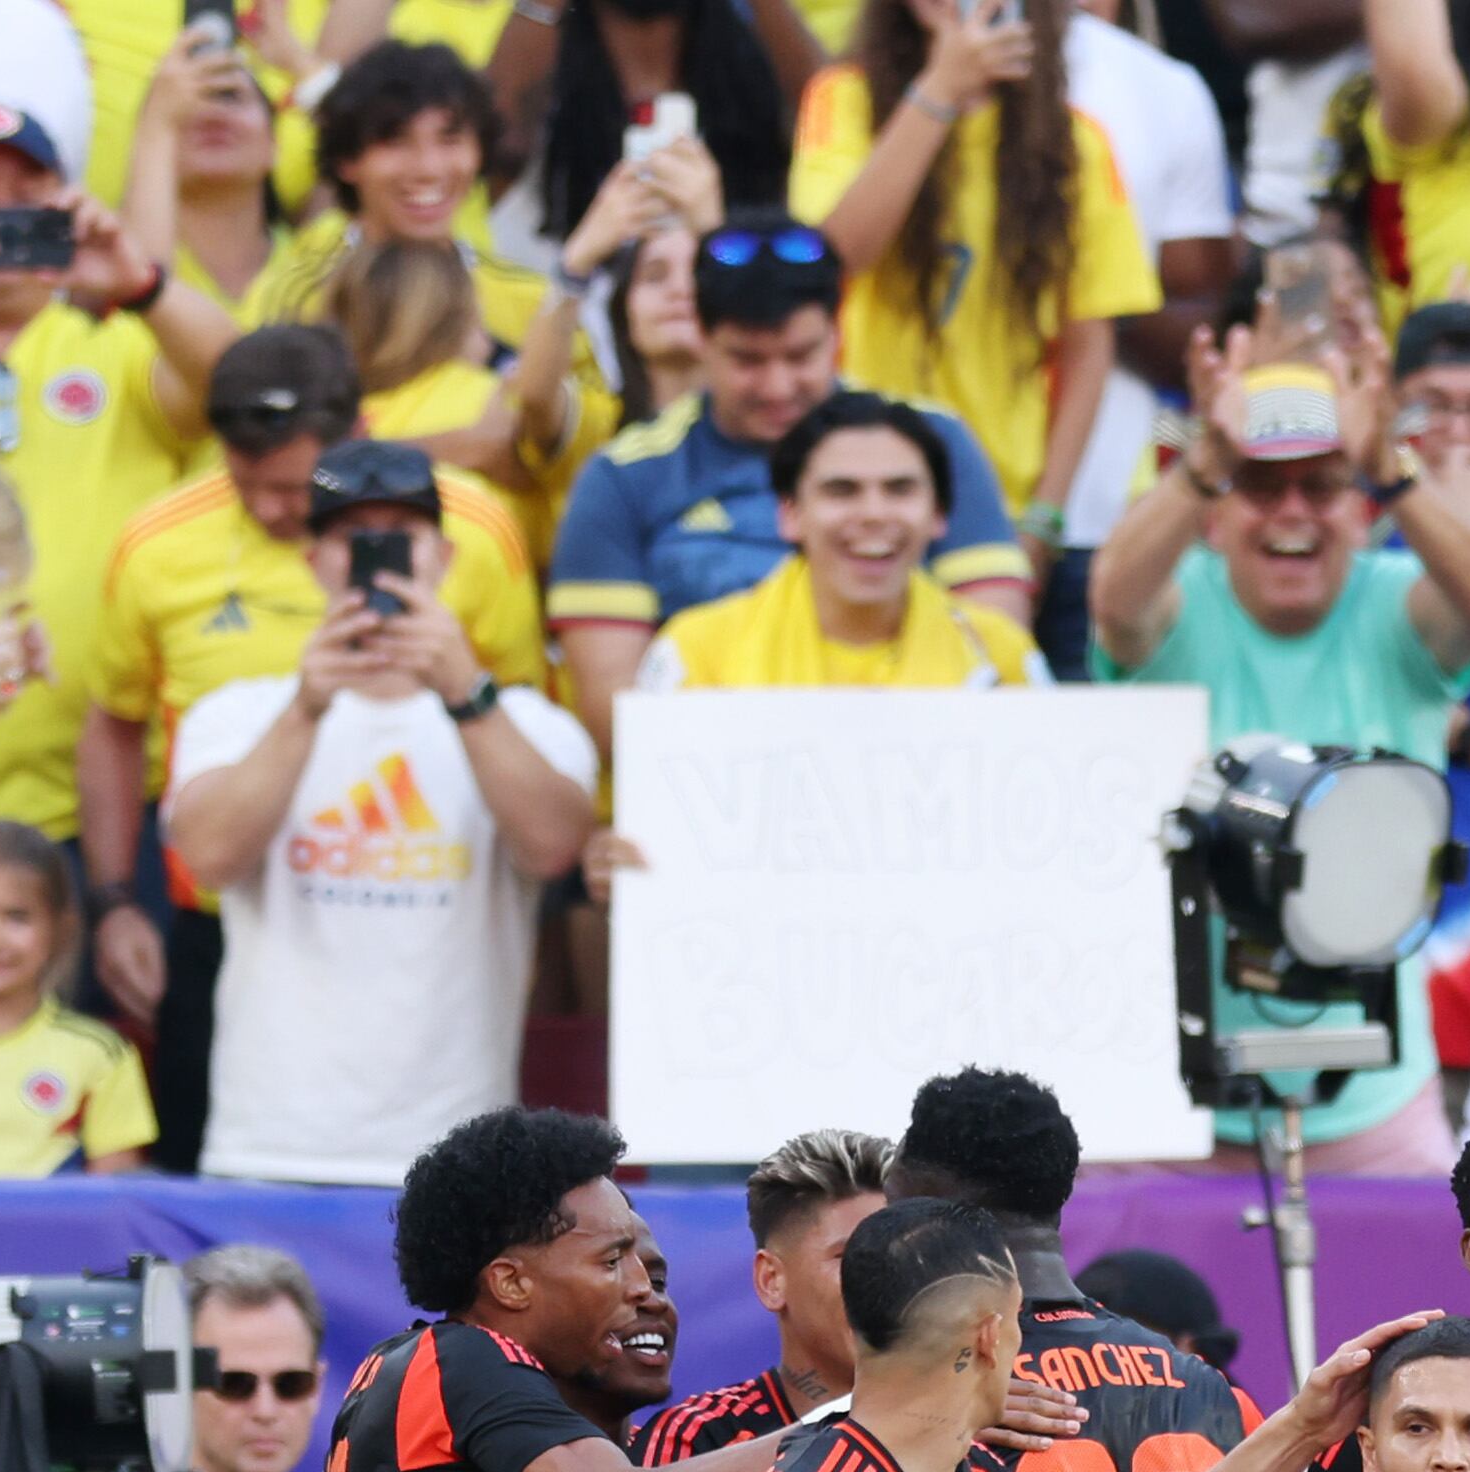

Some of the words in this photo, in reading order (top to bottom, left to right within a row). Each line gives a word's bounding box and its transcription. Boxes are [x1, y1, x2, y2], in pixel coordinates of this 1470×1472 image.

[656, 738, 1153, 892] VAMOS
[287, 834, 474, 883] adidas
[1013, 1343, 1186, 1395] SANCHEZ
